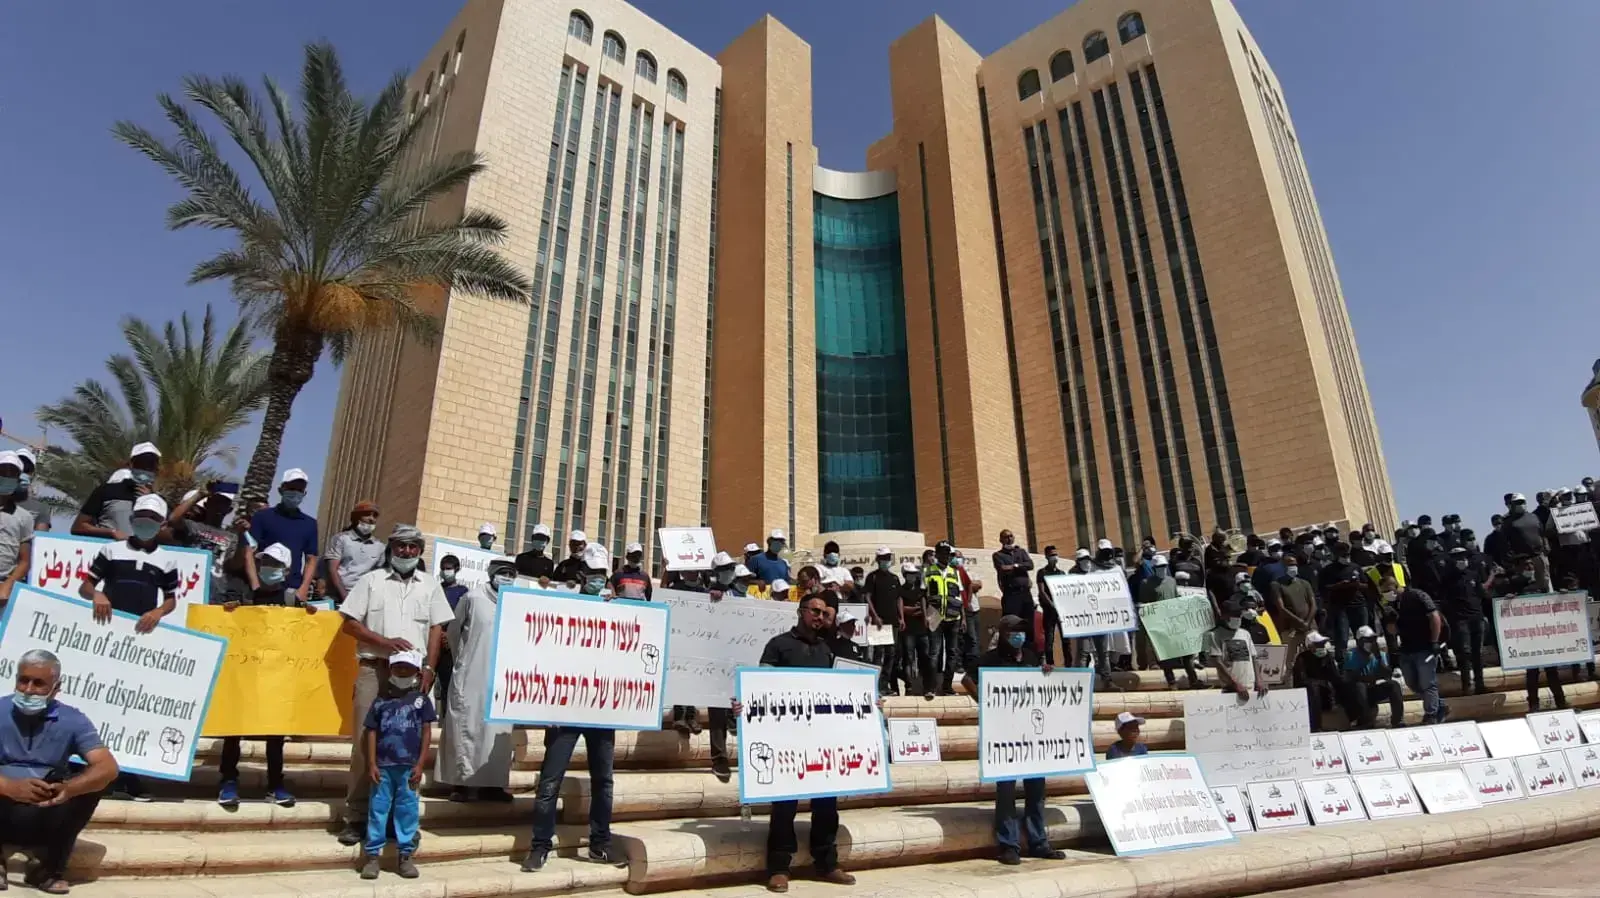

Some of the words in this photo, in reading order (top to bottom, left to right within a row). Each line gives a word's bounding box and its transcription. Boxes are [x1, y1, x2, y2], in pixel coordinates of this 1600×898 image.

[38, 548, 72, 588] وطن
[524, 611, 564, 646] הייעור
[566, 614, 607, 649] תוכנית
[610, 614, 641, 653] לעצור
[1120, 609, 1130, 626] כן
[28, 610, 58, 643] The
[55, 622, 92, 653] plan
[93, 631, 114, 657] of
[109, 636, 197, 677] afforestation
[80, 672, 106, 701] for
[105, 679, 197, 721] displacement
[551, 672, 589, 706] חירבת
[590, 667, 610, 709] של
[612, 676, 655, 712] והגירוש
[987, 680, 1035, 714] ולעקירה!
[1037, 680, 1067, 708] לייעור
[1070, 680, 1083, 706] לא
[746, 691, 768, 723] الوطن
[769, 691, 787, 722] خربة
[789, 691, 804, 721] قرية
[805, 690, 812, 726] في
[99, 722, 126, 753] lled
[126, 730, 150, 757] off.
[921, 736, 933, 756] أبو
[987, 733, 1034, 765] ולהכרה!
[1038, 730, 1071, 760] לבנייה
[1074, 737, 1085, 764] כן
[839, 744, 864, 776] حقوق
[866, 740, 881, 776] أين
